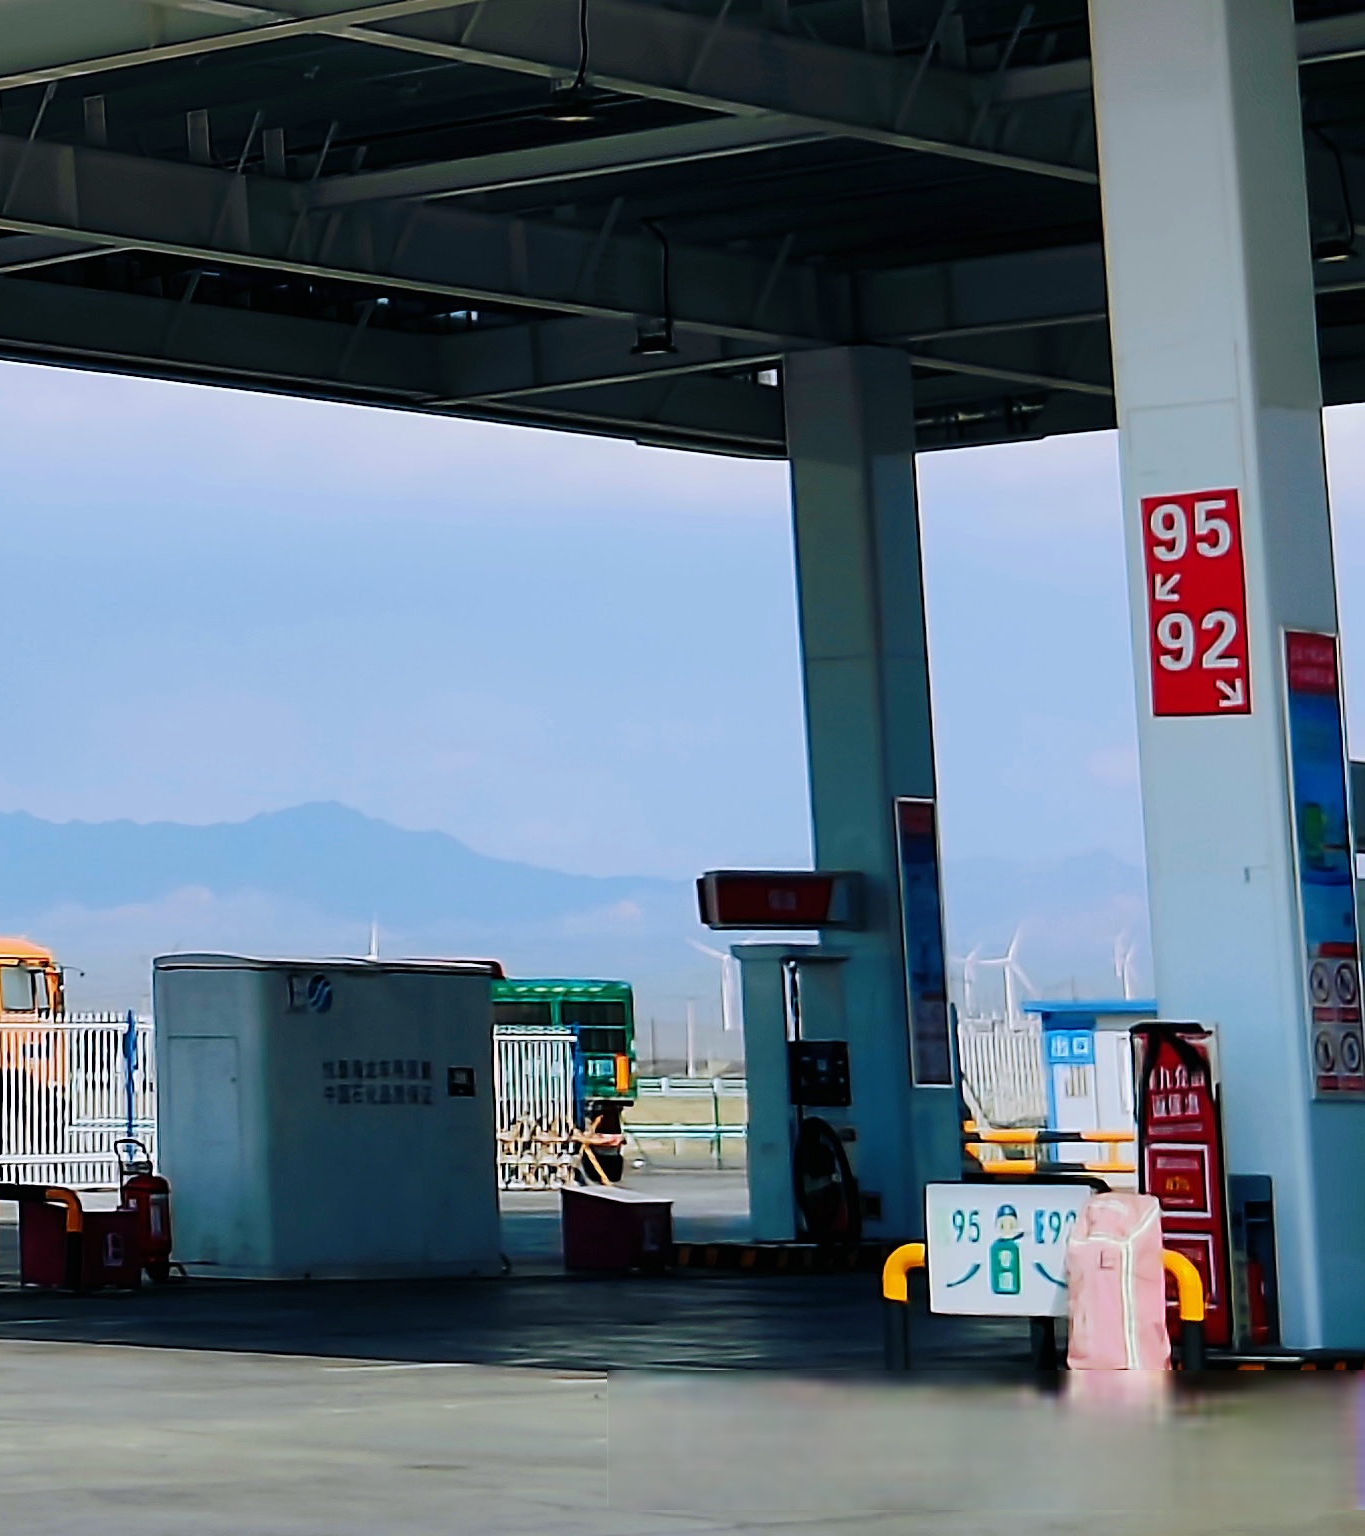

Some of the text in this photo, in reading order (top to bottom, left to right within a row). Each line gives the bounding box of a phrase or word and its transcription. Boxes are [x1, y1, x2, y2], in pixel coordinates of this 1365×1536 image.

[1150, 499, 1232, 562] 95
[1156, 610, 1239, 671] 92
[952, 1209, 980, 1243] 95
